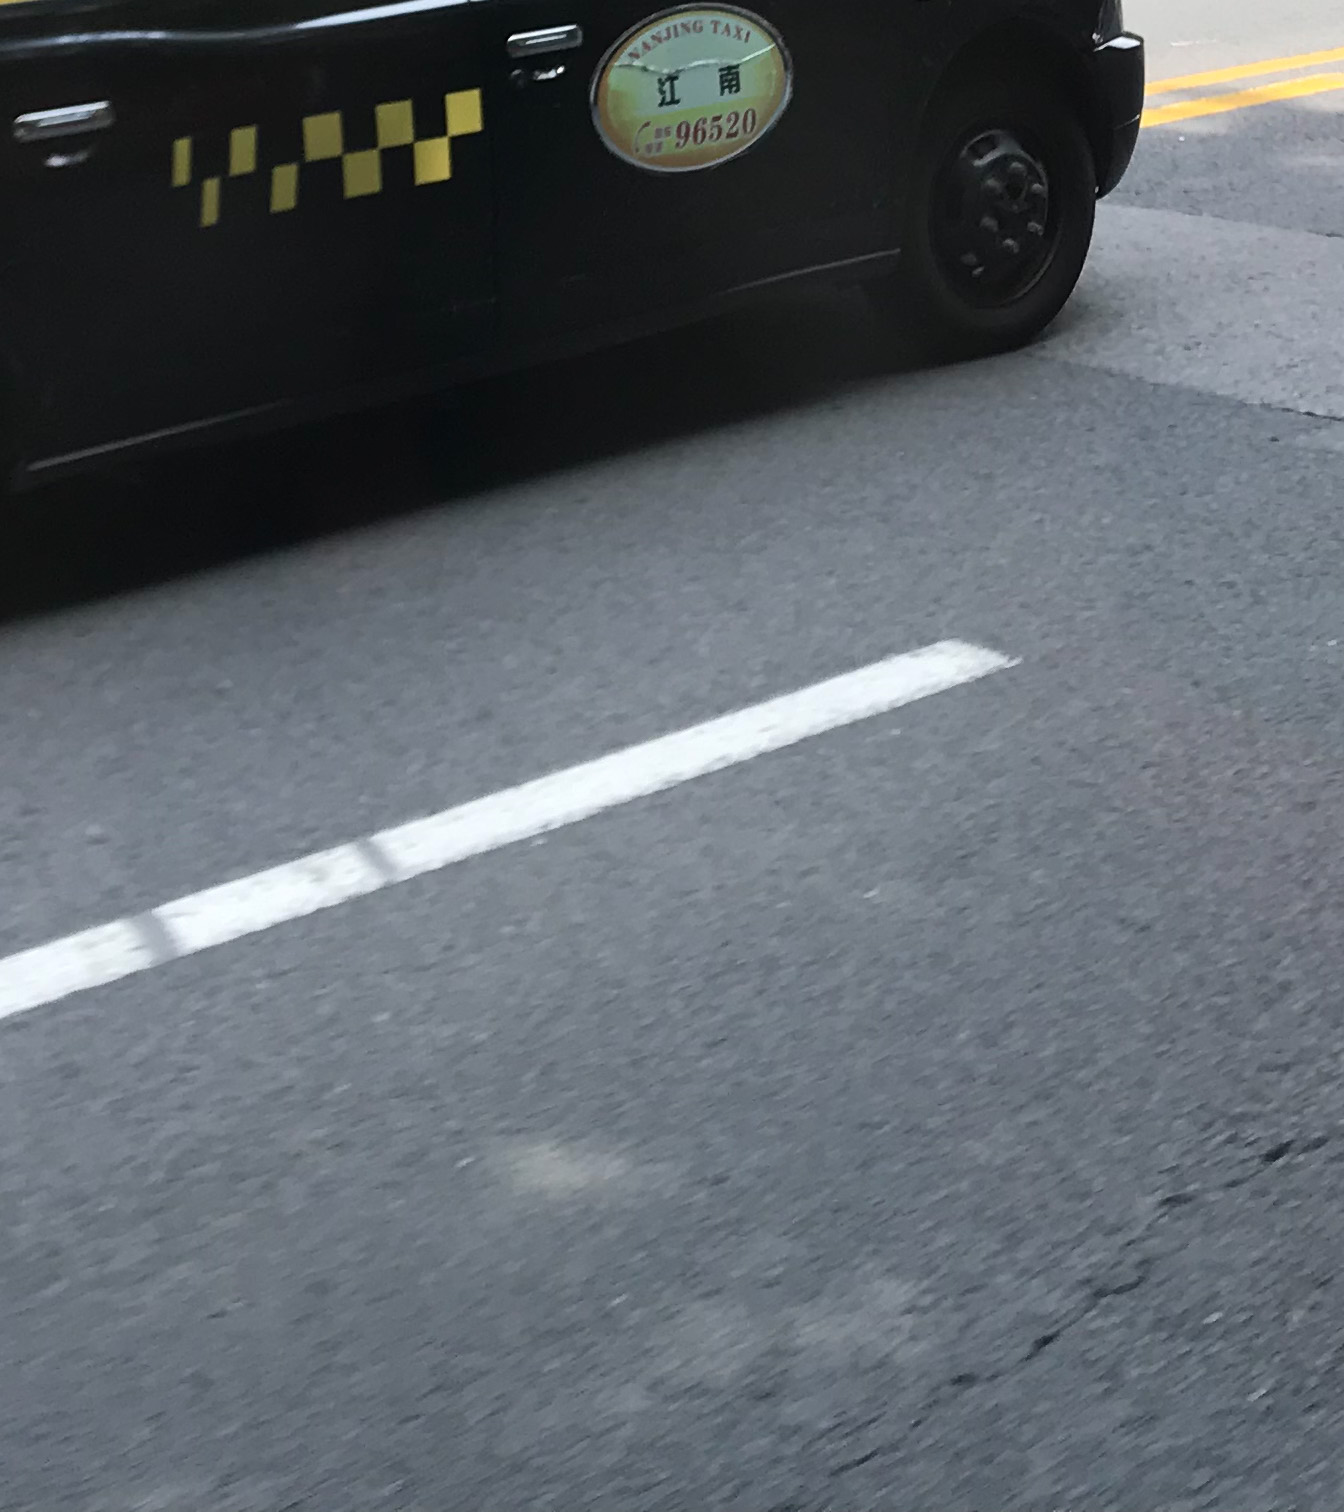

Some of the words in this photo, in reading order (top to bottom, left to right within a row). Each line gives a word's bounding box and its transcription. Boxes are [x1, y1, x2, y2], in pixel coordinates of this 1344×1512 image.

[627, 20, 704, 60] NANJING
[710, 19, 752, 44] TAXI
[657, 65, 742, 107] 江南
[674, 107, 758, 149] 96520
